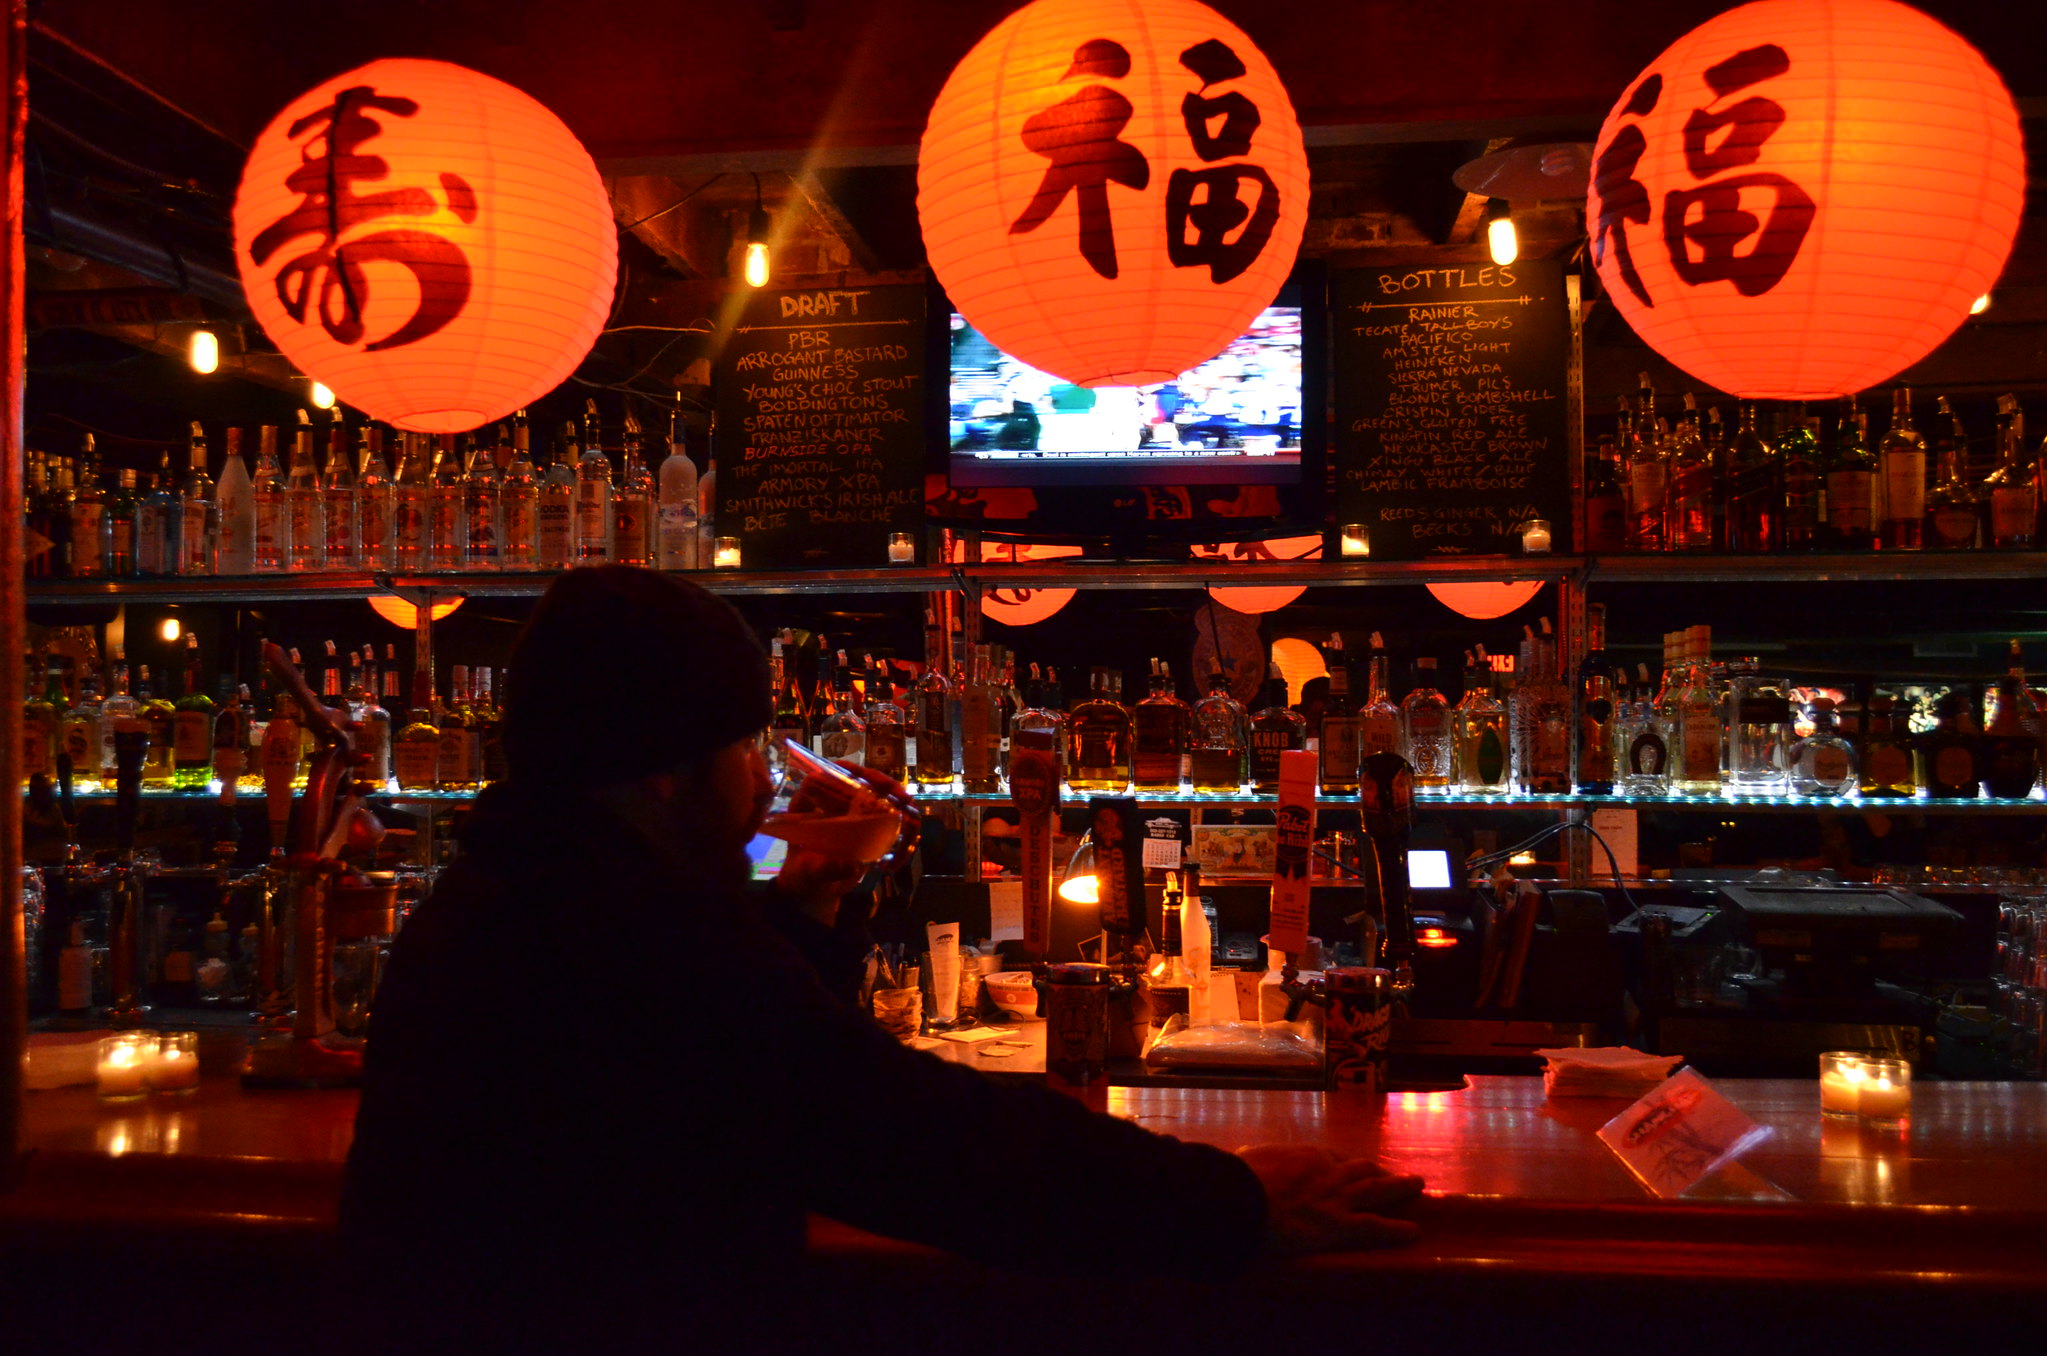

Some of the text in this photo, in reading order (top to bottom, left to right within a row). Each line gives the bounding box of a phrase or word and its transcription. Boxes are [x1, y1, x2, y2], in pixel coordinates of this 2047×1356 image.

[1008, 39, 1280, 284] 福
[1594, 44, 1816, 308] 福
[1378, 266, 1516, 294] BOTTLES
[780, 291, 870, 318] DRAFT
[1409, 306, 1479, 323] RAINIER
[1353, 324, 1409, 336] TECATE
[1400, 332, 1473, 346] PACIFICO
[789, 331, 830, 349] PBR
[736, 345, 907, 371] ARROGANT BASTARD
[1383, 342, 1510, 359] AMSTEL LIGHT
[1395, 353, 1471, 370] HEINEKEN
[773, 365, 859, 382] GUINNESS
[1388, 363, 1502, 385] SIERRA NEVADA
[743, 375, 919, 403] YOUNG'S CHOC STOUT
[1398, 376, 1511, 393] TRUMER PILS
[759, 394, 888, 413] BODDINGTONS
[1389, 390, 1556, 406] BLONDE BOMBSHELL
[743, 409, 909, 432] SPATEN OPTIMATOR
[1383, 405, 1514, 418] CRISPIN CIDER
[1352, 414, 1527, 432] GREEN'S GLUTEN FREE
[751, 428, 884, 445] FRANZISKANER
[1452, 429, 1486, 440] RED
[1496, 427, 1528, 439] ALE
[744, 444, 828, 460] BURNSIDE
[1384, 437, 1548, 455] NEWCASTLE BROWN
[1433, 454, 1486, 465] BLACK
[1498, 451, 1534, 462] ALE
[758, 473, 881, 495] ARMORY XPA
[1360, 477, 1530, 492] LAMBIC FRAMBOISE
[725, 494, 833, 513] SMITHWICK'S
[886, 488, 920, 504] ALE
[809, 506, 896, 524] BLANCHE
[1433, 507, 1496, 519] GINGER
[1254, 731, 1289, 748] KNOB
[1278, 812, 1310, 833] Pabst
[1028, 824, 1041, 943] DESCHUTES
